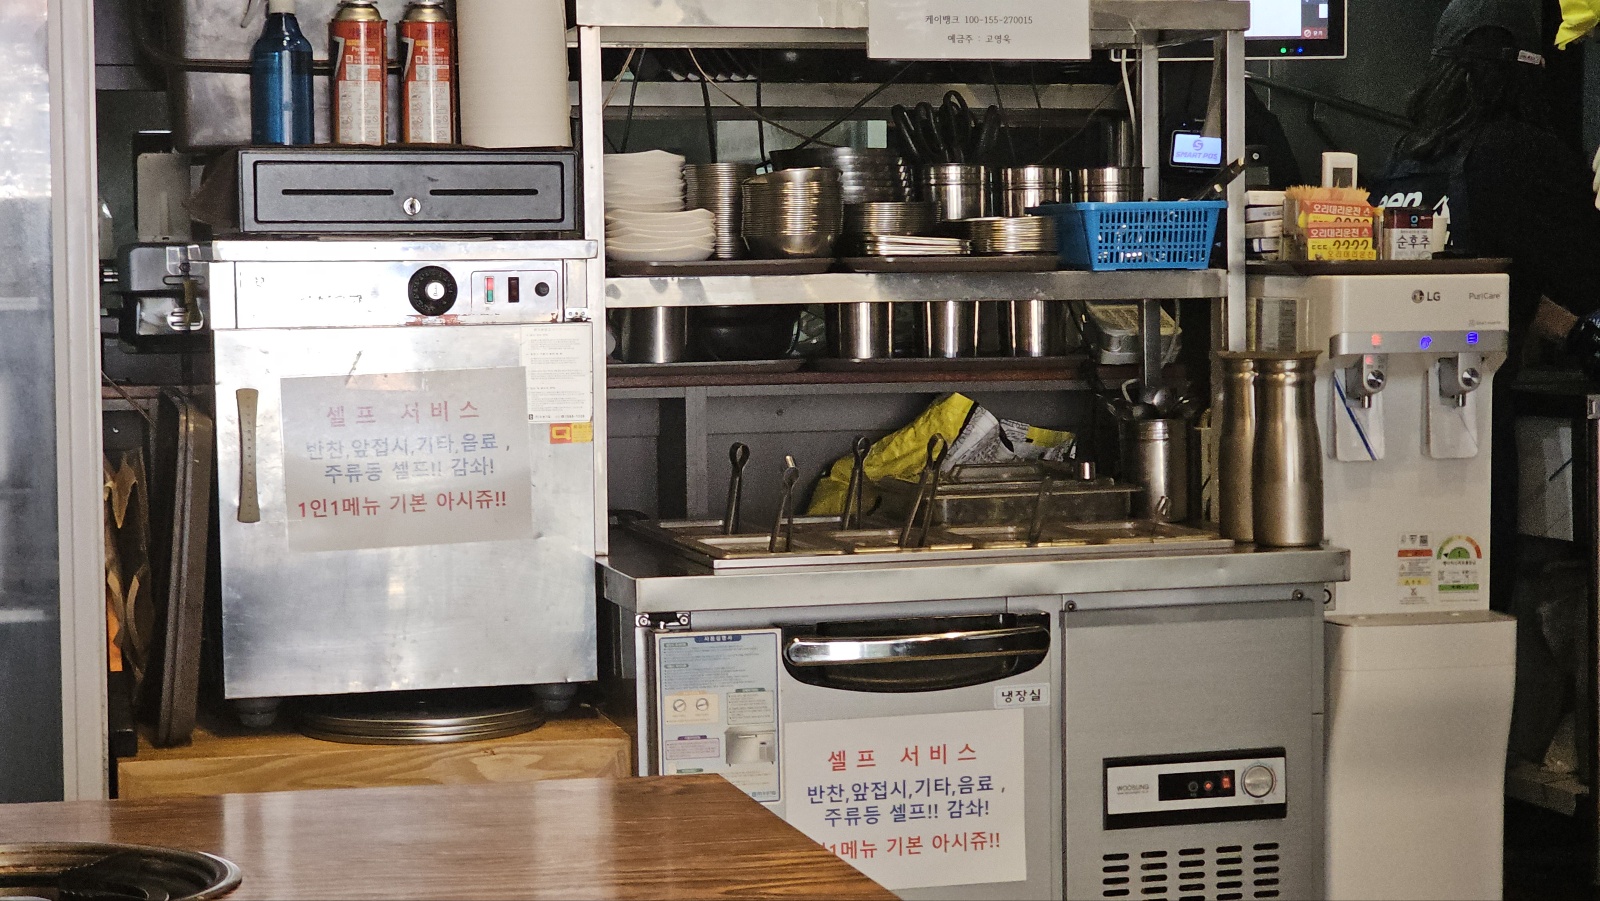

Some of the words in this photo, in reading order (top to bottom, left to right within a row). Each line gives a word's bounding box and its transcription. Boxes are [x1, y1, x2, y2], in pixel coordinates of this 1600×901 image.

[925, 14, 960, 25] 케이뱅크
[965, 15, 1033, 25] 100-155-270015
[947, 34, 973, 44] 예금주
[1175, 151, 1202, 159] SMART
[1202, 152, 1218, 160] POS
[1313, 203, 1361, 216] 오리대리운전
[1310, 228, 1360, 238] 오리대리운전
[1396, 234, 1431, 249] 순후추
[1426, 291, 1441, 302] LG
[1468, 292, 1501, 301] PuriCare
[326, 406, 376, 427] 셀프
[401, 401, 480, 424] 서비스
[324, 462, 383, 484] 주류등
[392, 460, 442, 480] 셀프!!
[298, 497, 381, 519] 1인1메뉴
[389, 493, 428, 514] 기본
[436, 490, 507, 511] 아시쥬!!
[1001, 689, 1041, 703] 냉장실
[827, 749, 877, 772] 셀프
[899, 743, 977, 767] 서비스
[824, 805, 882, 828] 주류등
[889, 803, 938, 823] 셀프!!
[886, 834, 924, 856] 기본
[931, 831, 1000, 854] 아시쥬!!
